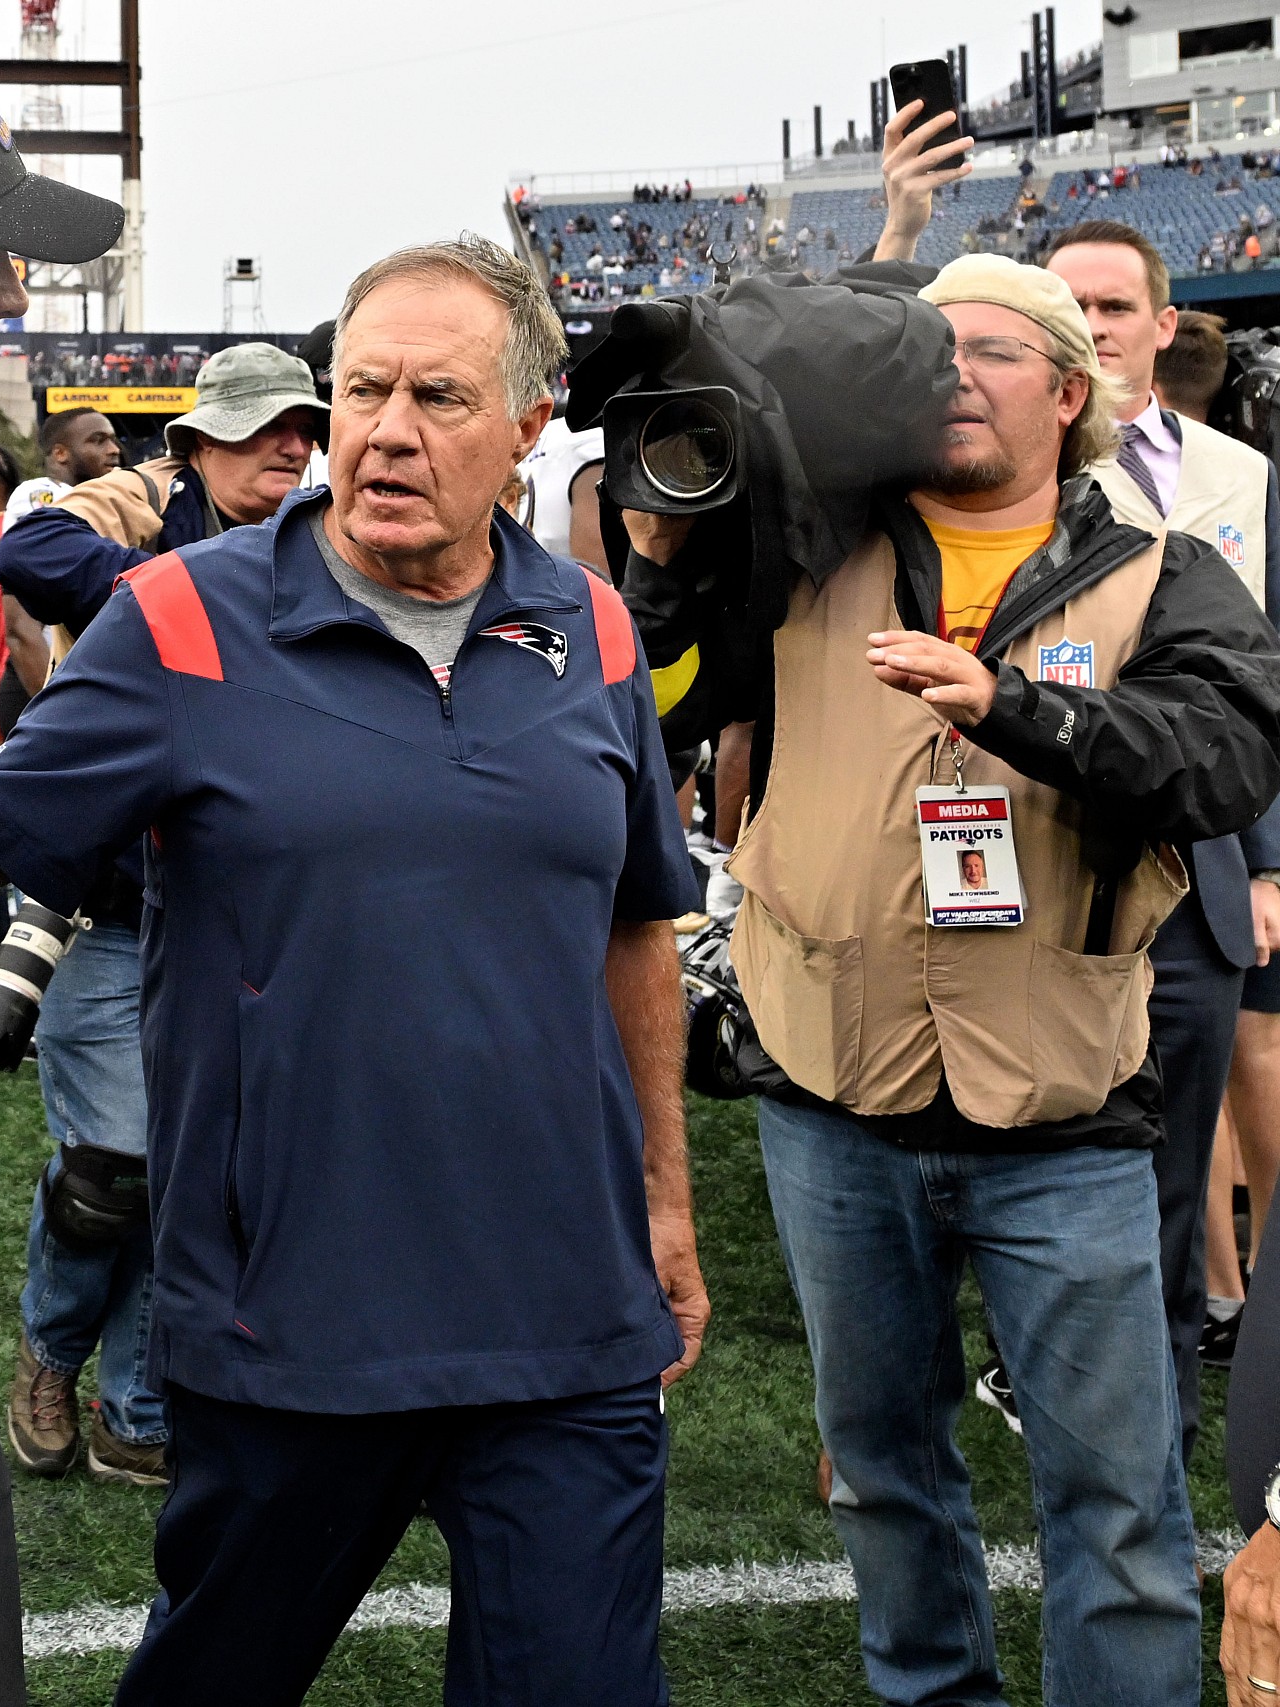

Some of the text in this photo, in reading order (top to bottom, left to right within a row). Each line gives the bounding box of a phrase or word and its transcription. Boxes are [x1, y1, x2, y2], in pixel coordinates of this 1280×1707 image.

[1222, 539, 1243, 563] NFL
[1045, 665, 1087, 689] NFL
[938, 804, 989, 818] MEDIA
[929, 828, 1004, 841] PATRIOTS
